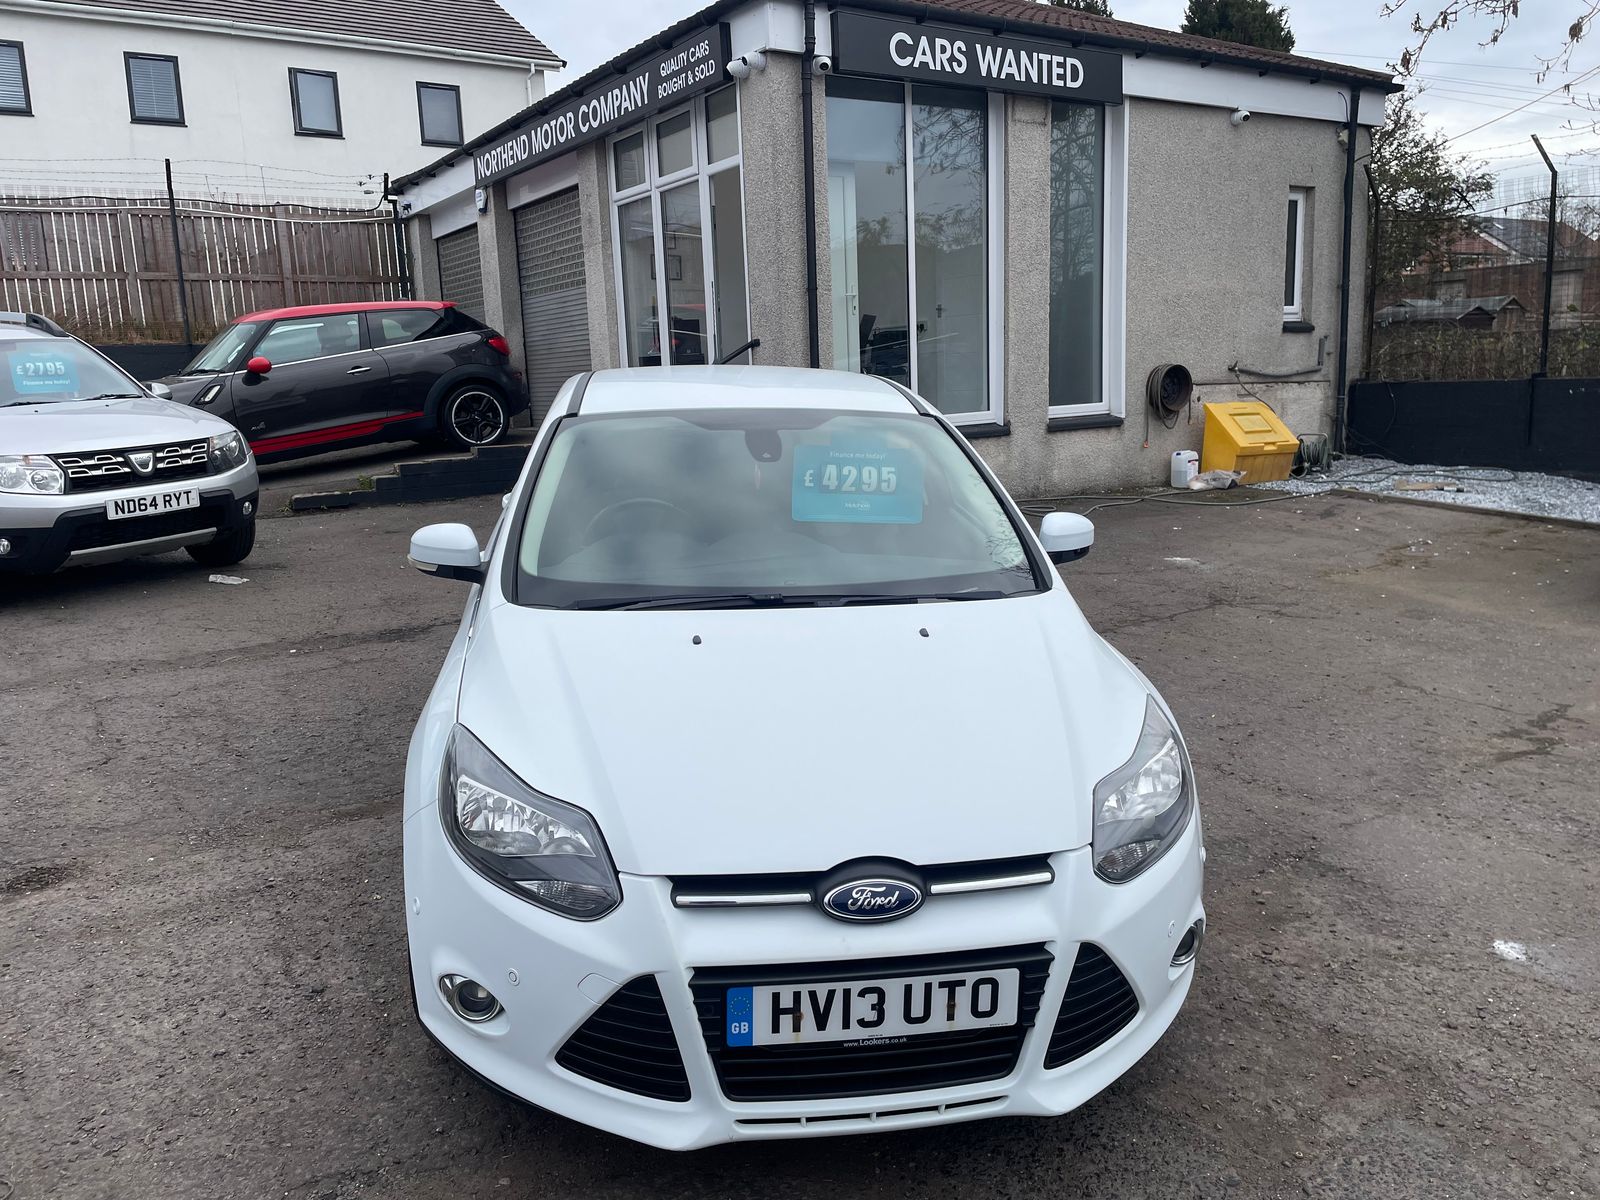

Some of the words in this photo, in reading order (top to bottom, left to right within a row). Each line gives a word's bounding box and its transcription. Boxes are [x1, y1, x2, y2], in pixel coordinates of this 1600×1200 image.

[659, 50, 688, 77] QUALITY
[688, 39, 710, 62] CARS
[889, 31, 968, 75] CARS
[975, 43, 1085, 89] WANTED
[657, 72, 686, 99] BOUGHT
[687, 70, 694, 85] &
[694, 59, 716, 82] SOLD
[476, 134, 529, 180] NORTHEND
[531, 112, 576, 156] MOTOR
[577, 71, 650, 133] COMPANY
[25, 361, 65, 376] 2795
[804, 469, 815, 488] £
[822, 464, 897, 493] 4295
[114, 501, 159, 516] ND64
[163, 490, 193, 508] RYT
[847, 886, 900, 910] Ford
[770, 986, 887, 1035] HV13
[902, 976, 1000, 1025] UTO
[731, 1021, 750, 1034] GB
[843, 1037, 908, 1048] www.Lookers.co.uk
